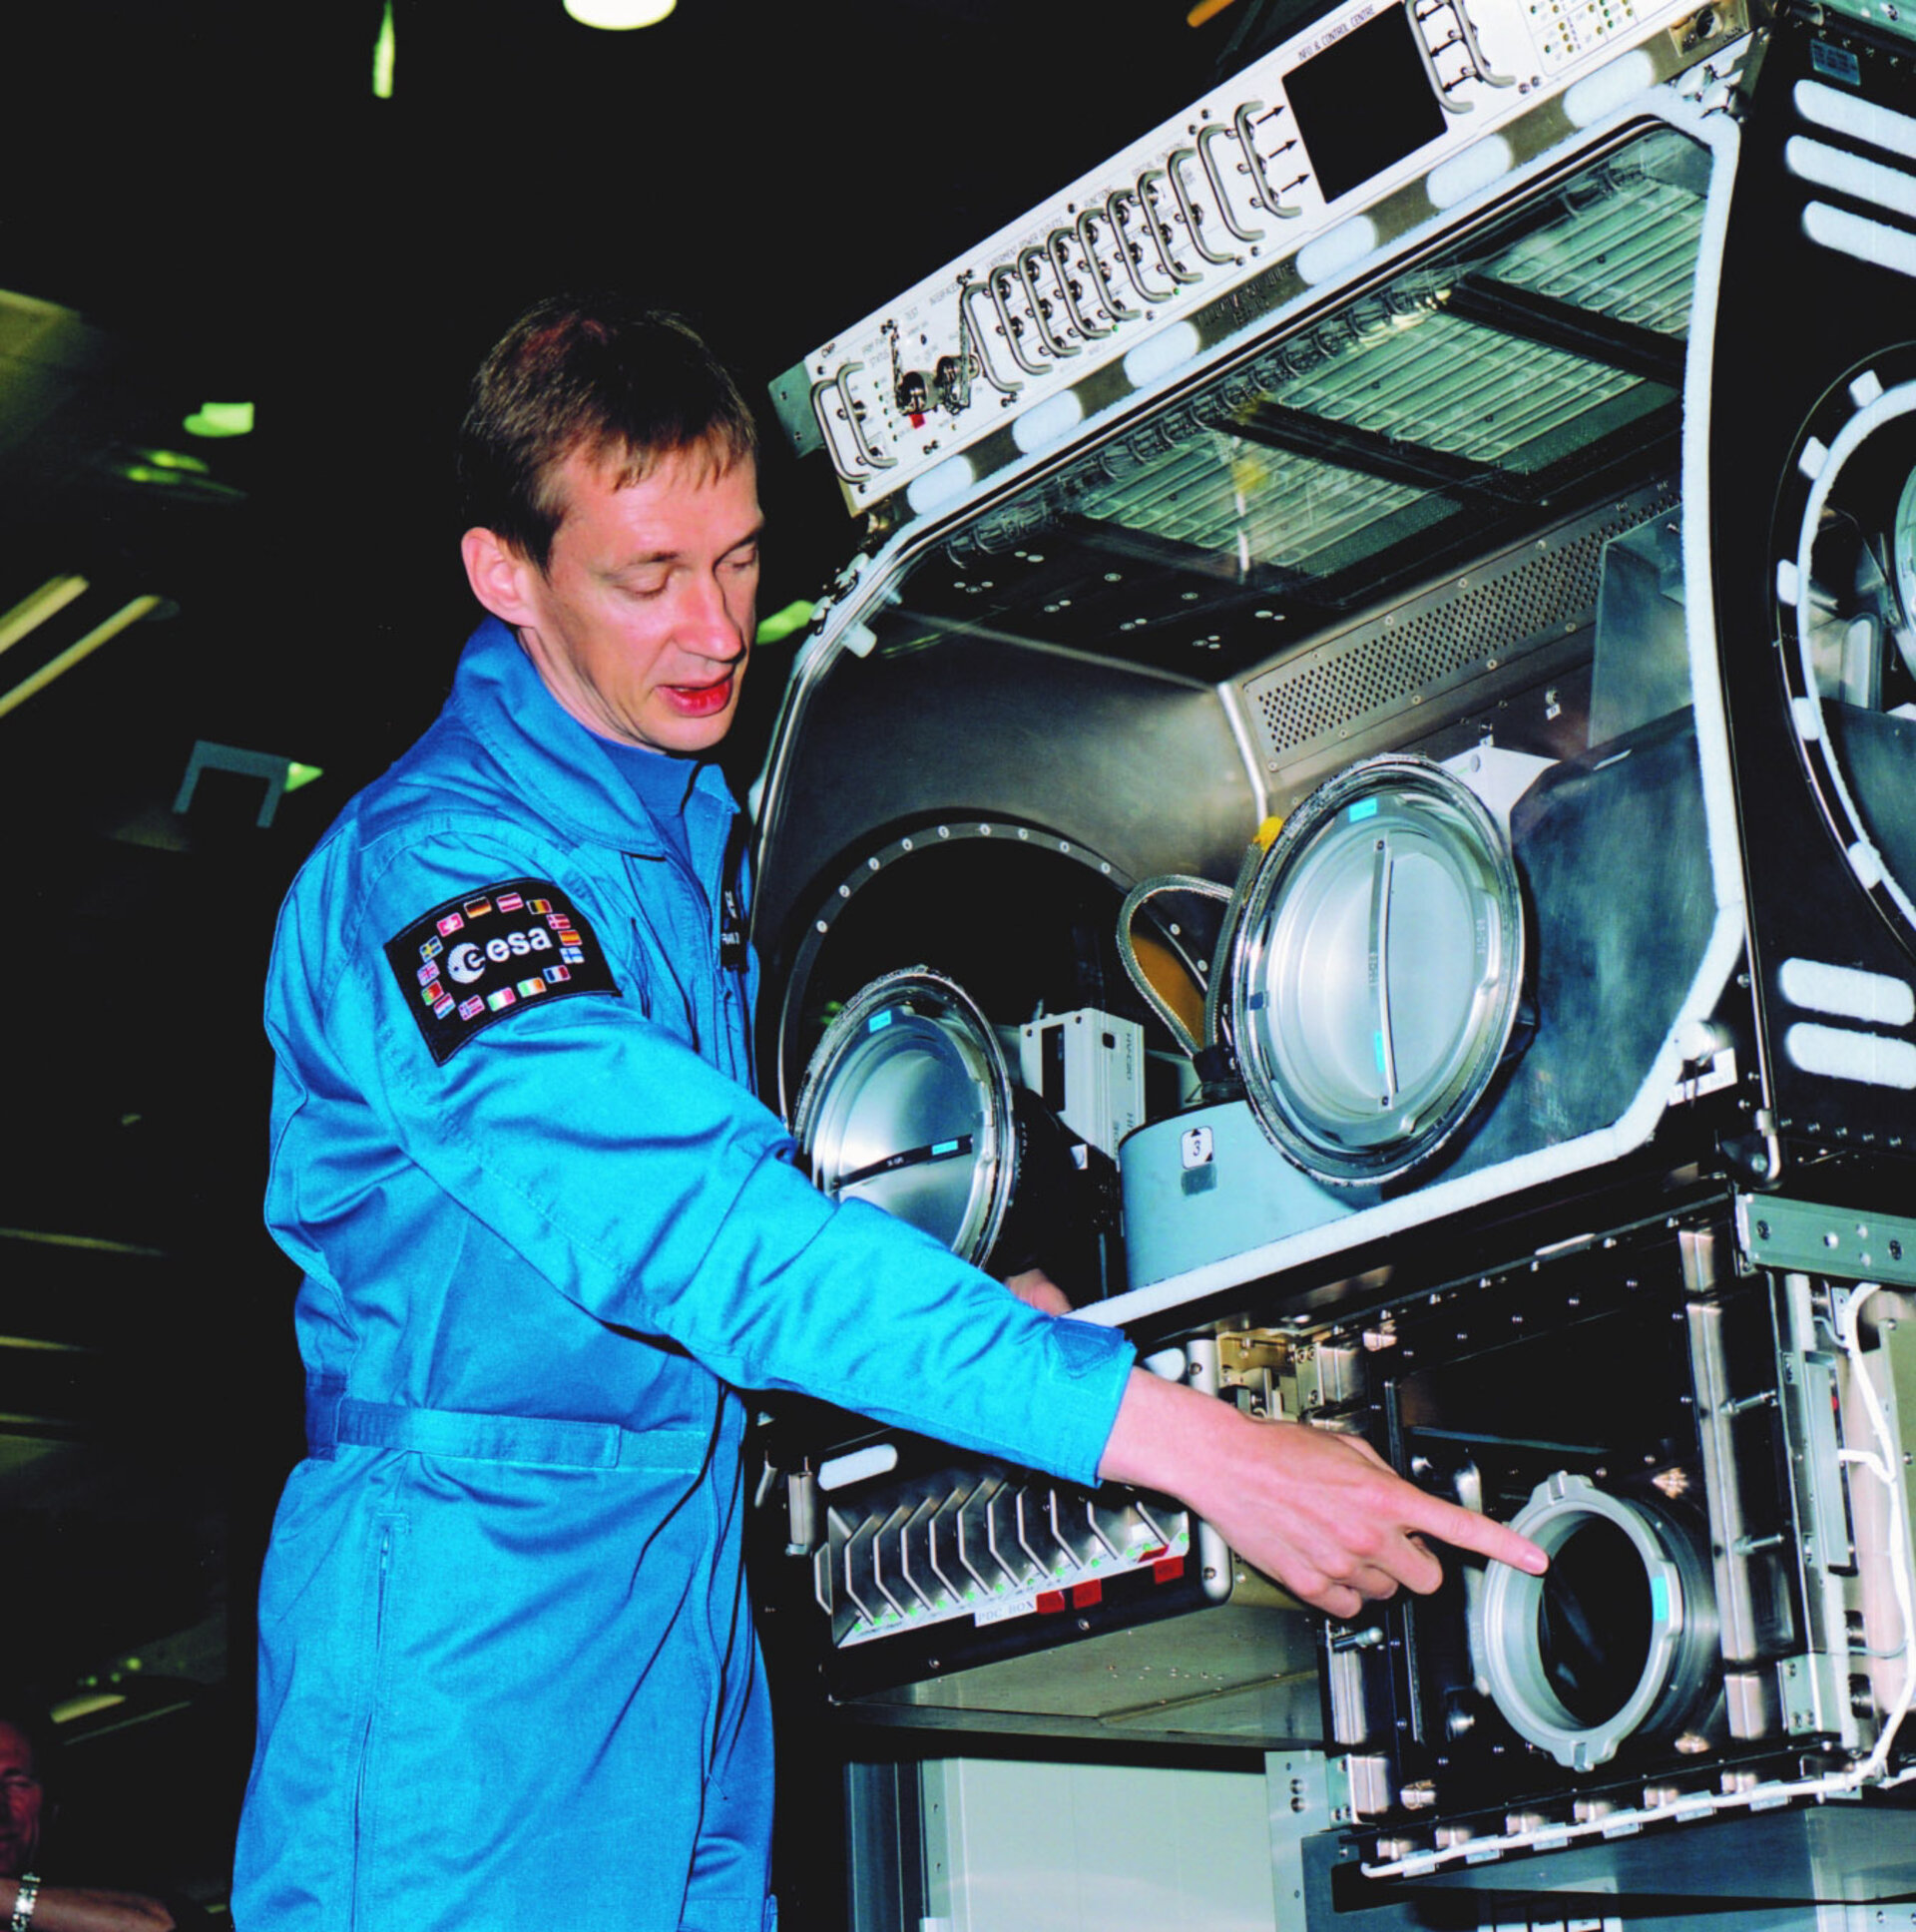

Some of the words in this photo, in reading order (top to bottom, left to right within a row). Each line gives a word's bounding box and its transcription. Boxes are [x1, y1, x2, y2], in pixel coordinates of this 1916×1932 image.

[1321, 23, 1349, 46] CONTROL
[1193, 1140, 1200, 1157] 3
[978, 1607, 1003, 1624] PDC
[1008, 1600, 1034, 1615] BOX
